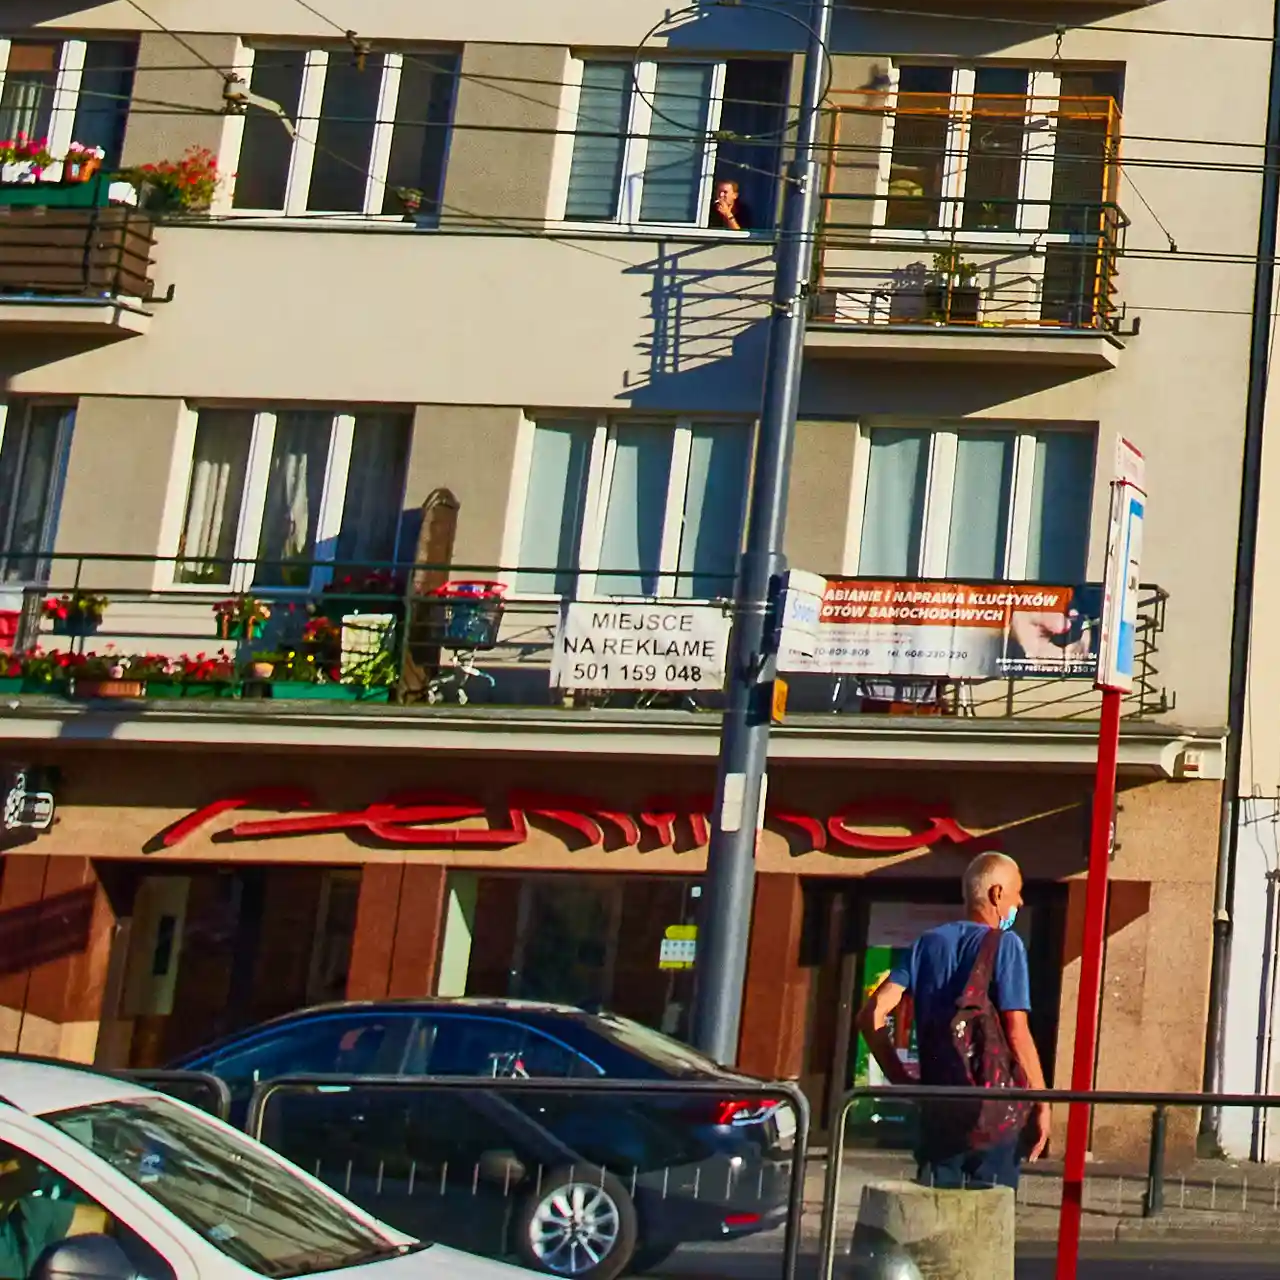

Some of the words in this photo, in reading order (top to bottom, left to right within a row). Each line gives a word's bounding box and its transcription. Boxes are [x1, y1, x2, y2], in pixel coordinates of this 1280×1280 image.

[824, 588, 883, 602] ABIANIE
[893, 591, 965, 604] NAPRAWA
[967, 592, 1058, 607] KLUCZYKÓW
[821, 603, 868, 618] OTÓW
[868, 605, 1004, 621] SAMOCHODOWYCH
[591, 612, 693, 632] MIEJSCE
[563, 637, 595, 654] NA
[602, 638, 715, 662] REKLAMĘ
[573, 663, 610, 681] 501
[620, 664, 657, 682] 159
[665, 664, 702, 682] 048
